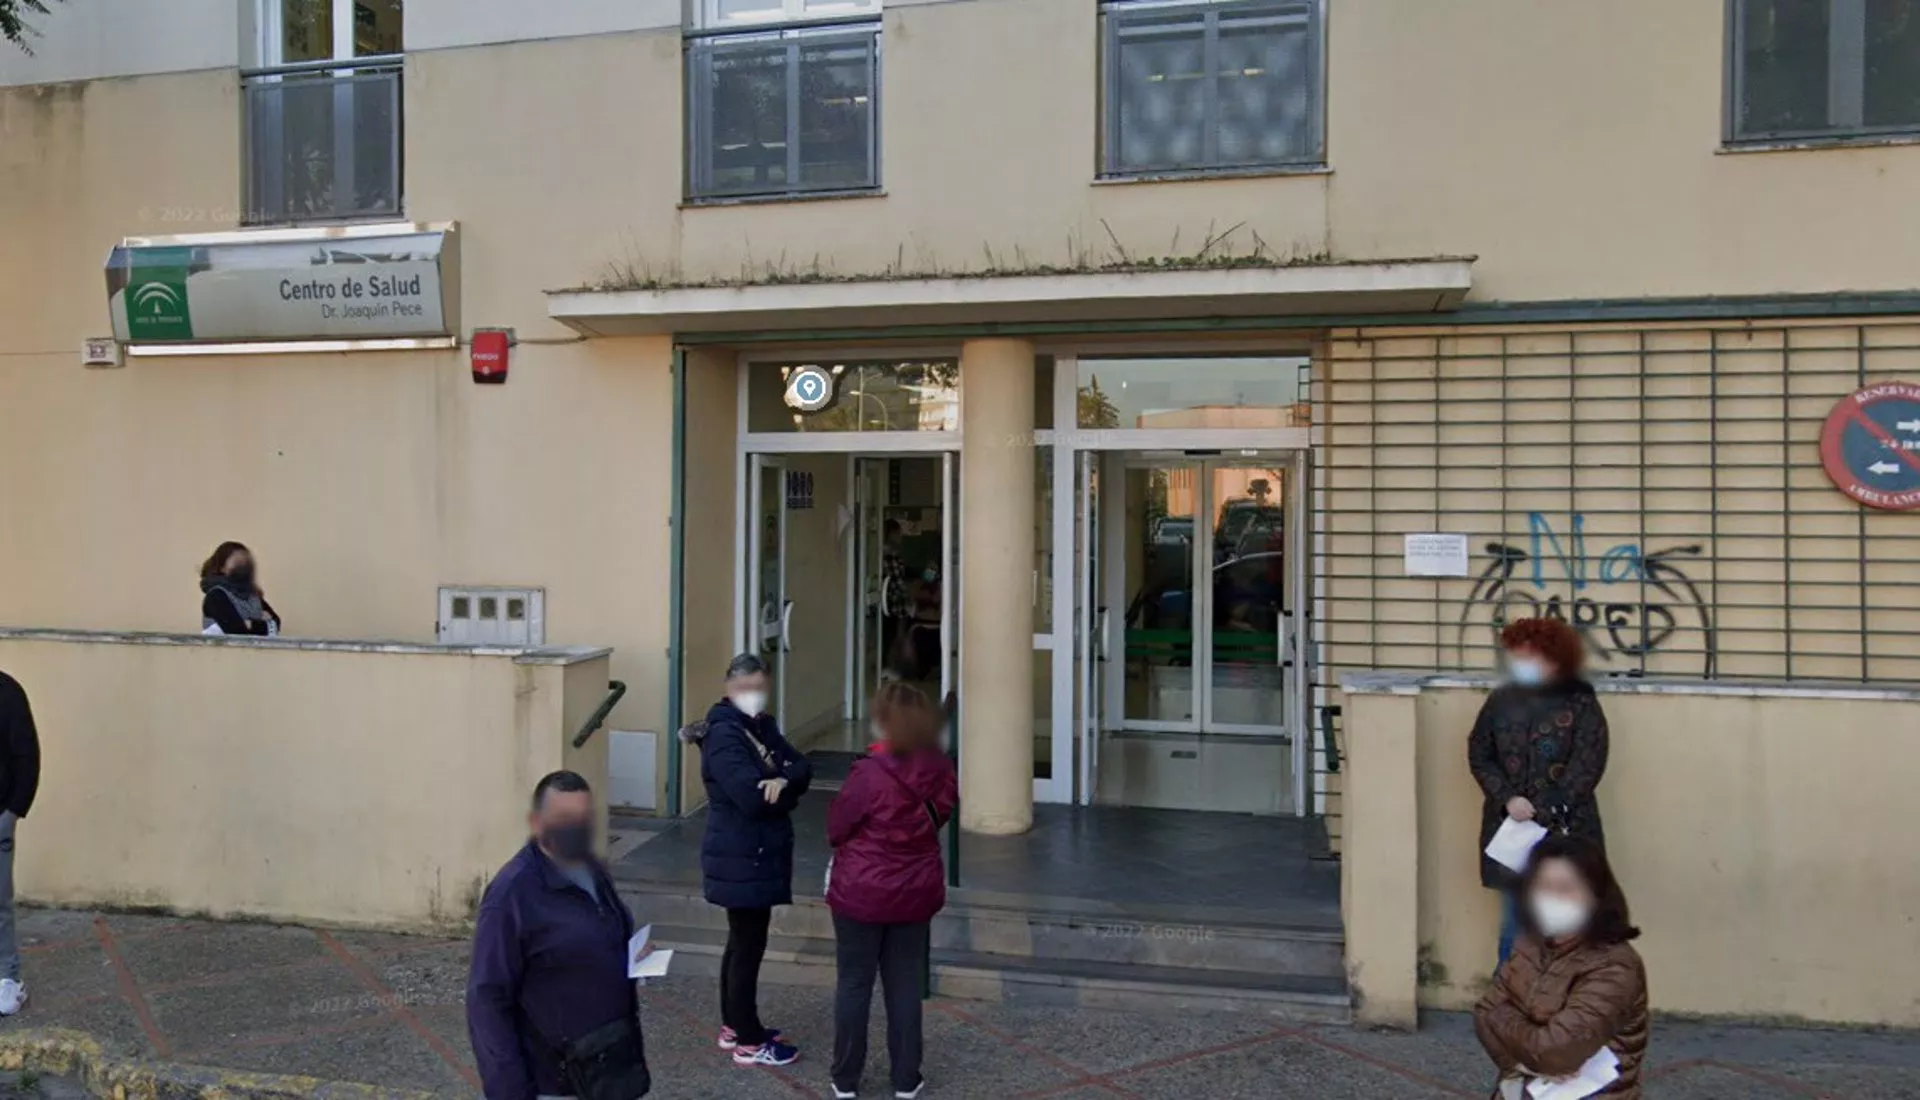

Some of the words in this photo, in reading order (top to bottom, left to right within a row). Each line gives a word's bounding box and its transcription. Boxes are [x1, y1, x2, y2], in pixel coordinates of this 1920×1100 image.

[280, 278, 336, 301] Centro
[341, 277, 363, 298] de
[369, 274, 421, 297] Salud
[321, 303, 339, 319] Dr.
[342, 302, 389, 320] Joaquín
[392, 301, 422, 317] Pece
